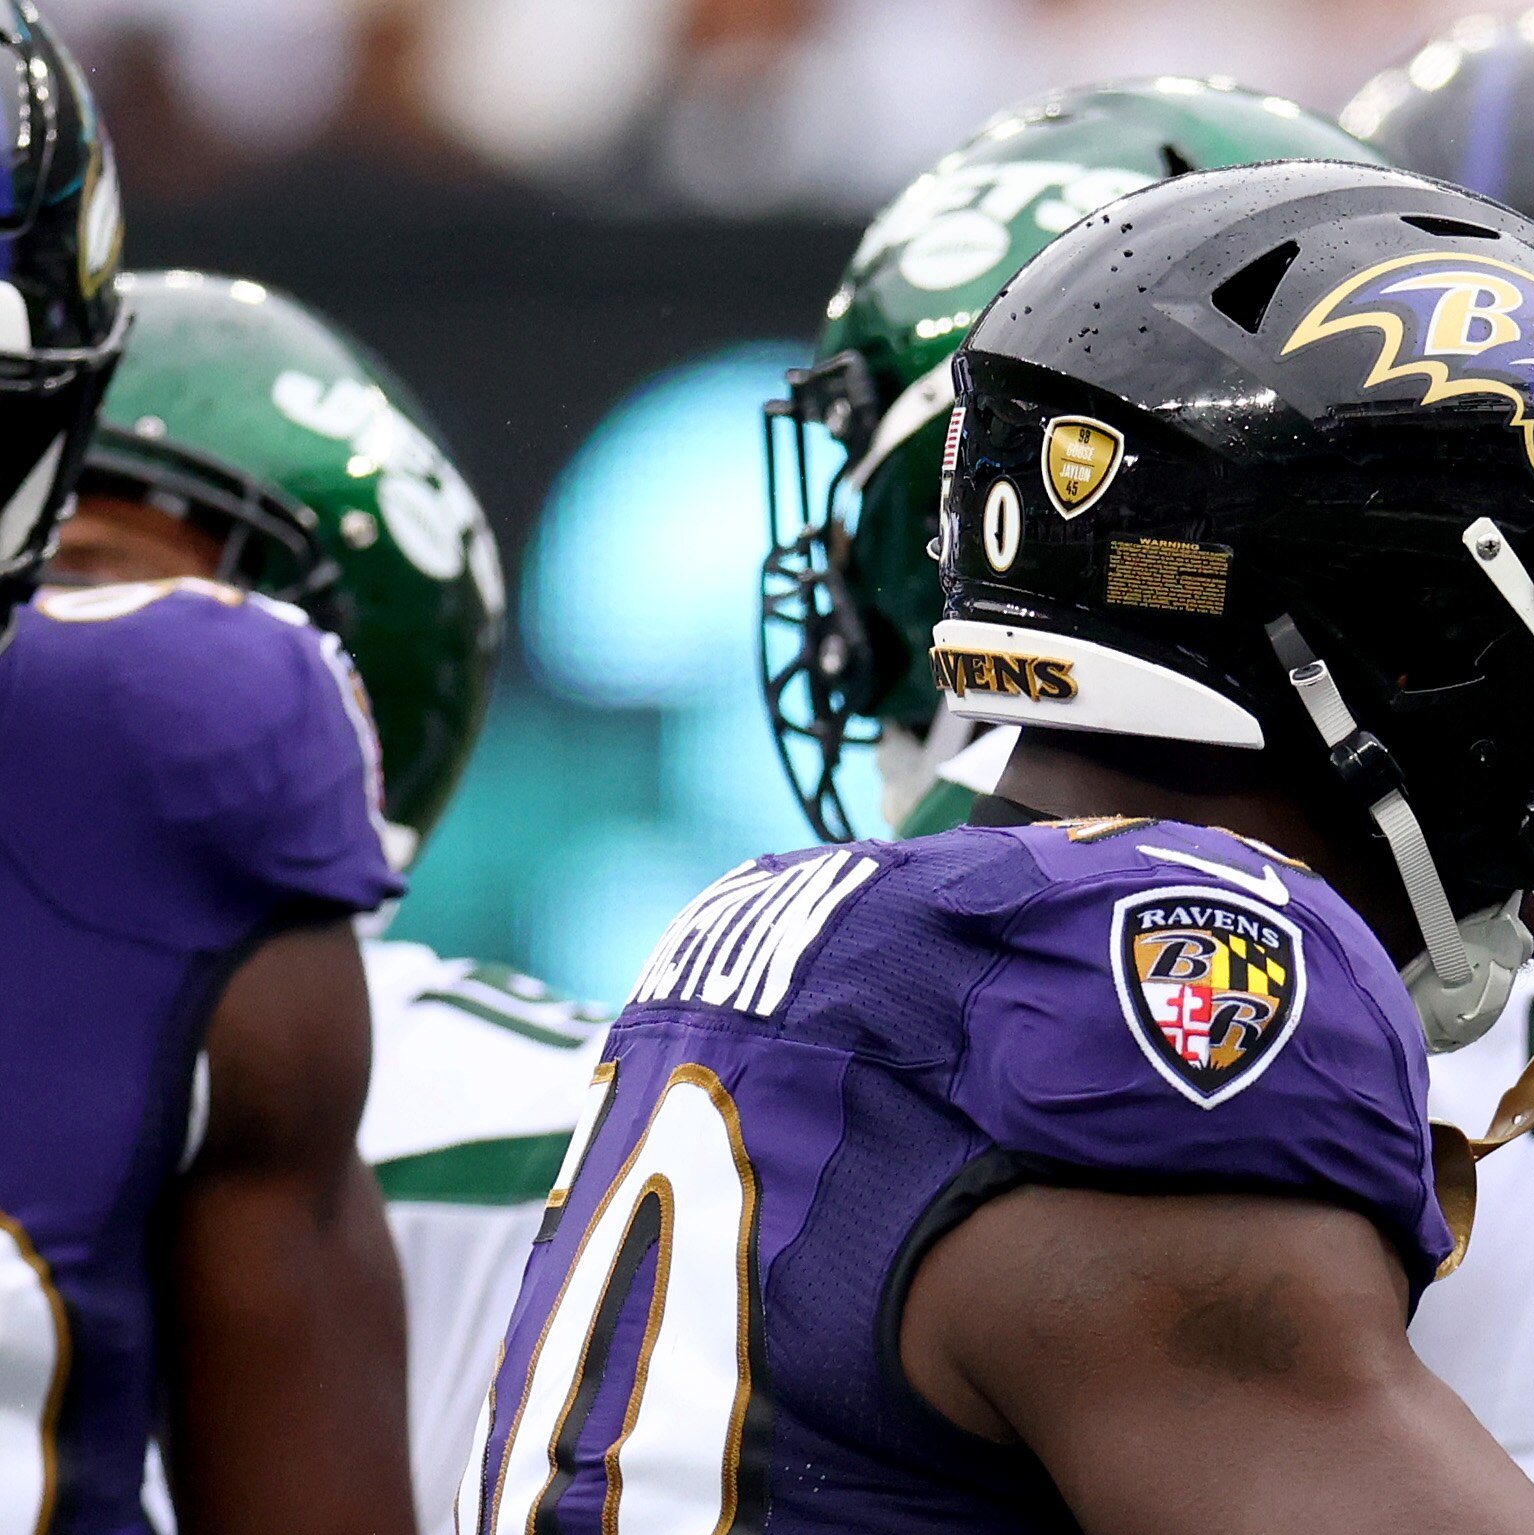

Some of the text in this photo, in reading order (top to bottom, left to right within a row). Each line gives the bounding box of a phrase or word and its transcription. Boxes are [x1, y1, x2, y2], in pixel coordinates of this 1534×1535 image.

[1078, 428, 1092, 445] 98
[1059, 463, 1093, 482] JAYLON
[1066, 480, 1079, 497] 45
[1140, 538, 1200, 550] WARNING
[929, 646, 1079, 702] AVENS
[1137, 906, 1280, 949] RAVENS
